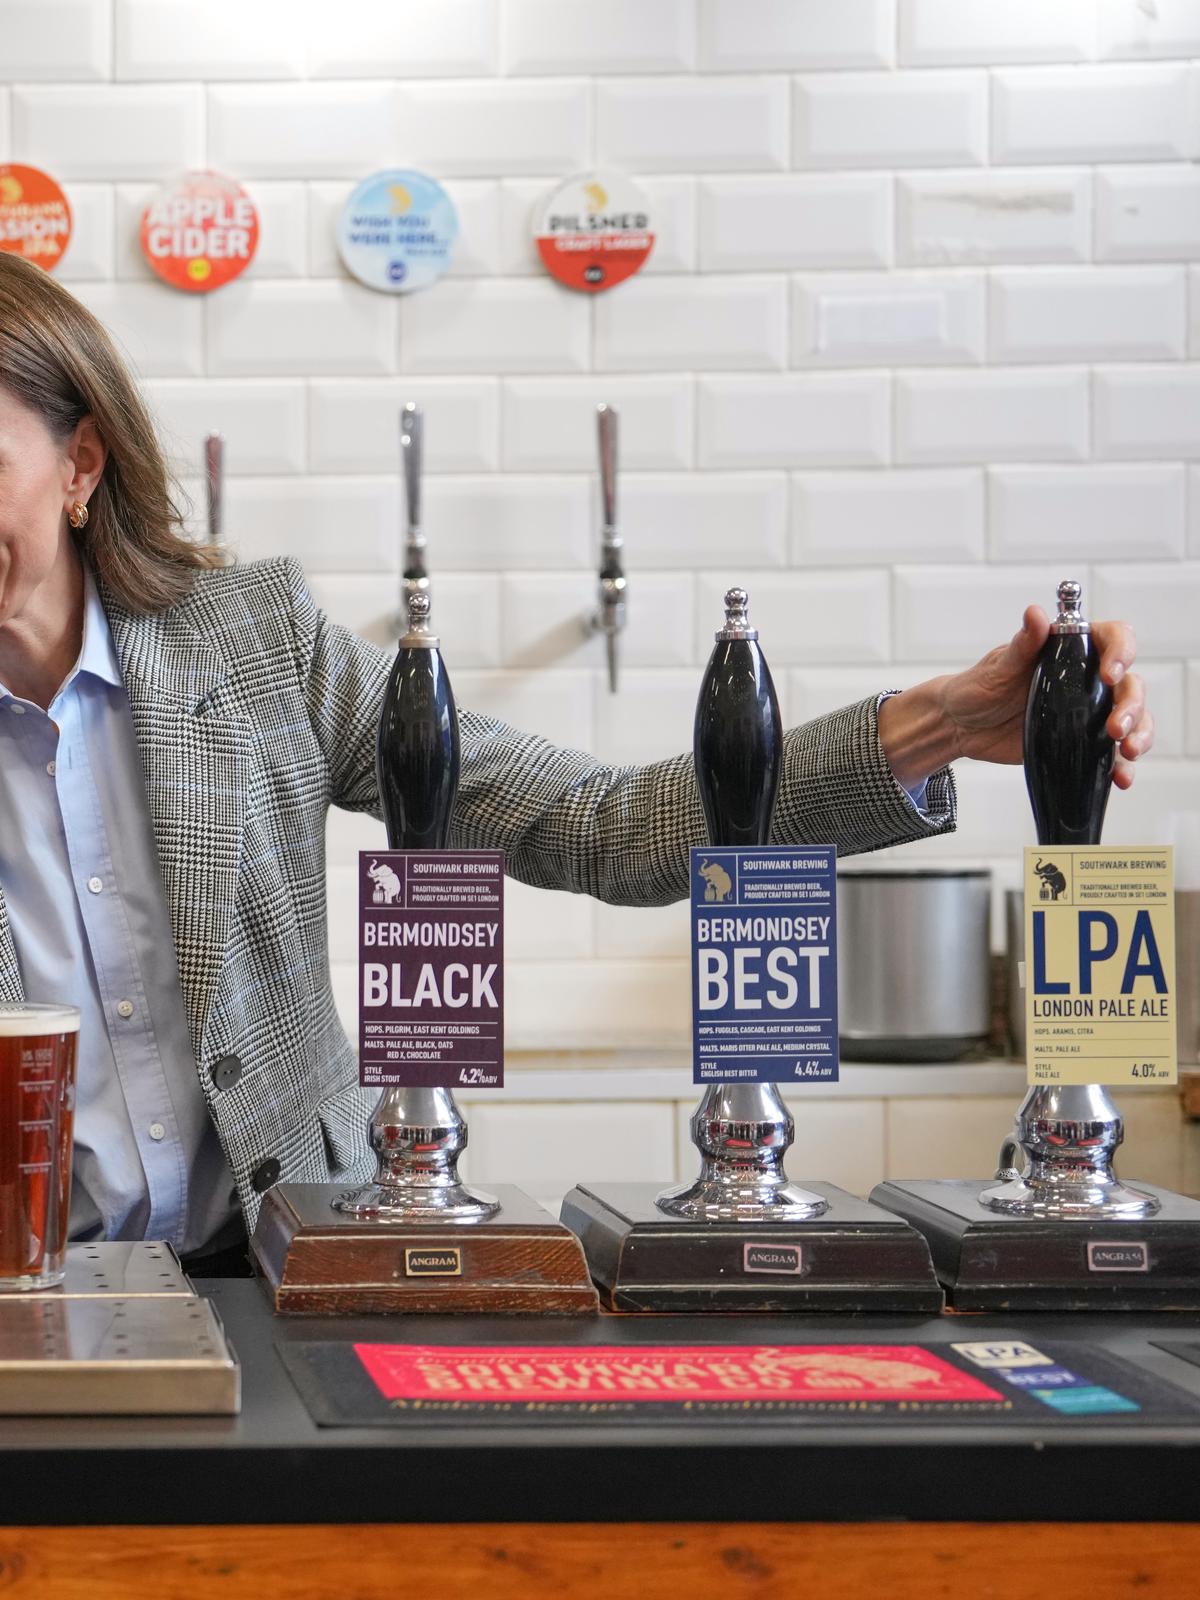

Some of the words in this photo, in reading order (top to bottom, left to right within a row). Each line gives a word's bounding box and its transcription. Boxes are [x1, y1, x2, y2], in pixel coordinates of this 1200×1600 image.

[148, 198, 254, 226] APPLE
[550, 213, 648, 231] PILSNER
[148, 228, 250, 258] CIDER
[413, 864, 462, 874] SOUTHWARK
[463, 864, 499, 874] BREWING
[743, 861, 791, 870] SOUTHWARK
[792, 860, 828, 870] BREWING
[1080, 861, 1128, 870] SOUTHWARK
[1130, 860, 1167, 869] BREWING
[412, 885, 452, 893] TRADITIONALLY
[452, 885, 475, 893] BREWED
[783, 883, 806, 891] BREWED
[412, 894, 436, 902] PROUDLY
[436, 894, 460, 902] CRAFTED
[768, 891, 791, 899] CRAFTED
[809, 890, 830, 898] LONDON
[697, 916, 831, 942] BERMONDSEY
[364, 922, 499, 947] BERMONDSEY
[1032, 910, 1169, 994] LPA
[698, 946, 830, 1010] BEST
[363, 962, 499, 1008] BLACK
[1033, 1000, 1094, 1017] LONDON
[1099, 999, 1136, 1017] PALE
[1140, 999, 1169, 1016] ALE
[385, 1026, 412, 1034] PILGRIM,
[413, 1026, 430, 1034] EAST
[431, 1026, 447, 1034] KENT
[448, 1026, 480, 1034] GOLDINGS
[780, 1025, 794, 1033] KENT
[794, 1025, 821, 1033] GOLDINGS
[386, 1041, 401, 1049] PALE
[402, 1041, 415, 1050] ALE,
[415, 1041, 437, 1050] BLACK,
[438, 1041, 454, 1049] OATS
[720, 1044, 738, 1052] MARIS
[756, 1043, 770, 1051] PALE
[783, 1043, 805, 1051] MEDIUM
[387, 1051, 399, 1059] RED
[406, 1051, 441, 1059] CHOCOLATE
[364, 1066, 382, 1074] STYLE
[701, 1062, 717, 1070] STYLE
[794, 1061, 820, 1076] 4.4%
[820, 1068, 832, 1076] ABV
[1131, 1063, 1156, 1078] 4.0%
[701, 1070, 724, 1078] ENGLISH
[738, 1069, 758, 1077] BITTER
[381, 1075, 400, 1083] STOUT
[410, 1257, 456, 1266] ANGRAM
[750, 1253, 797, 1264] ANGRAM
[1094, 1252, 1142, 1261] ANGRAM
[964, 1345, 1034, 1359] LPA
[416, 1363, 792, 1377] SOUTHWARK
[1006, 1370, 1076, 1384] BEST
[425, 1375, 700, 1391] BREWING
[718, 1375, 792, 1391] CO
